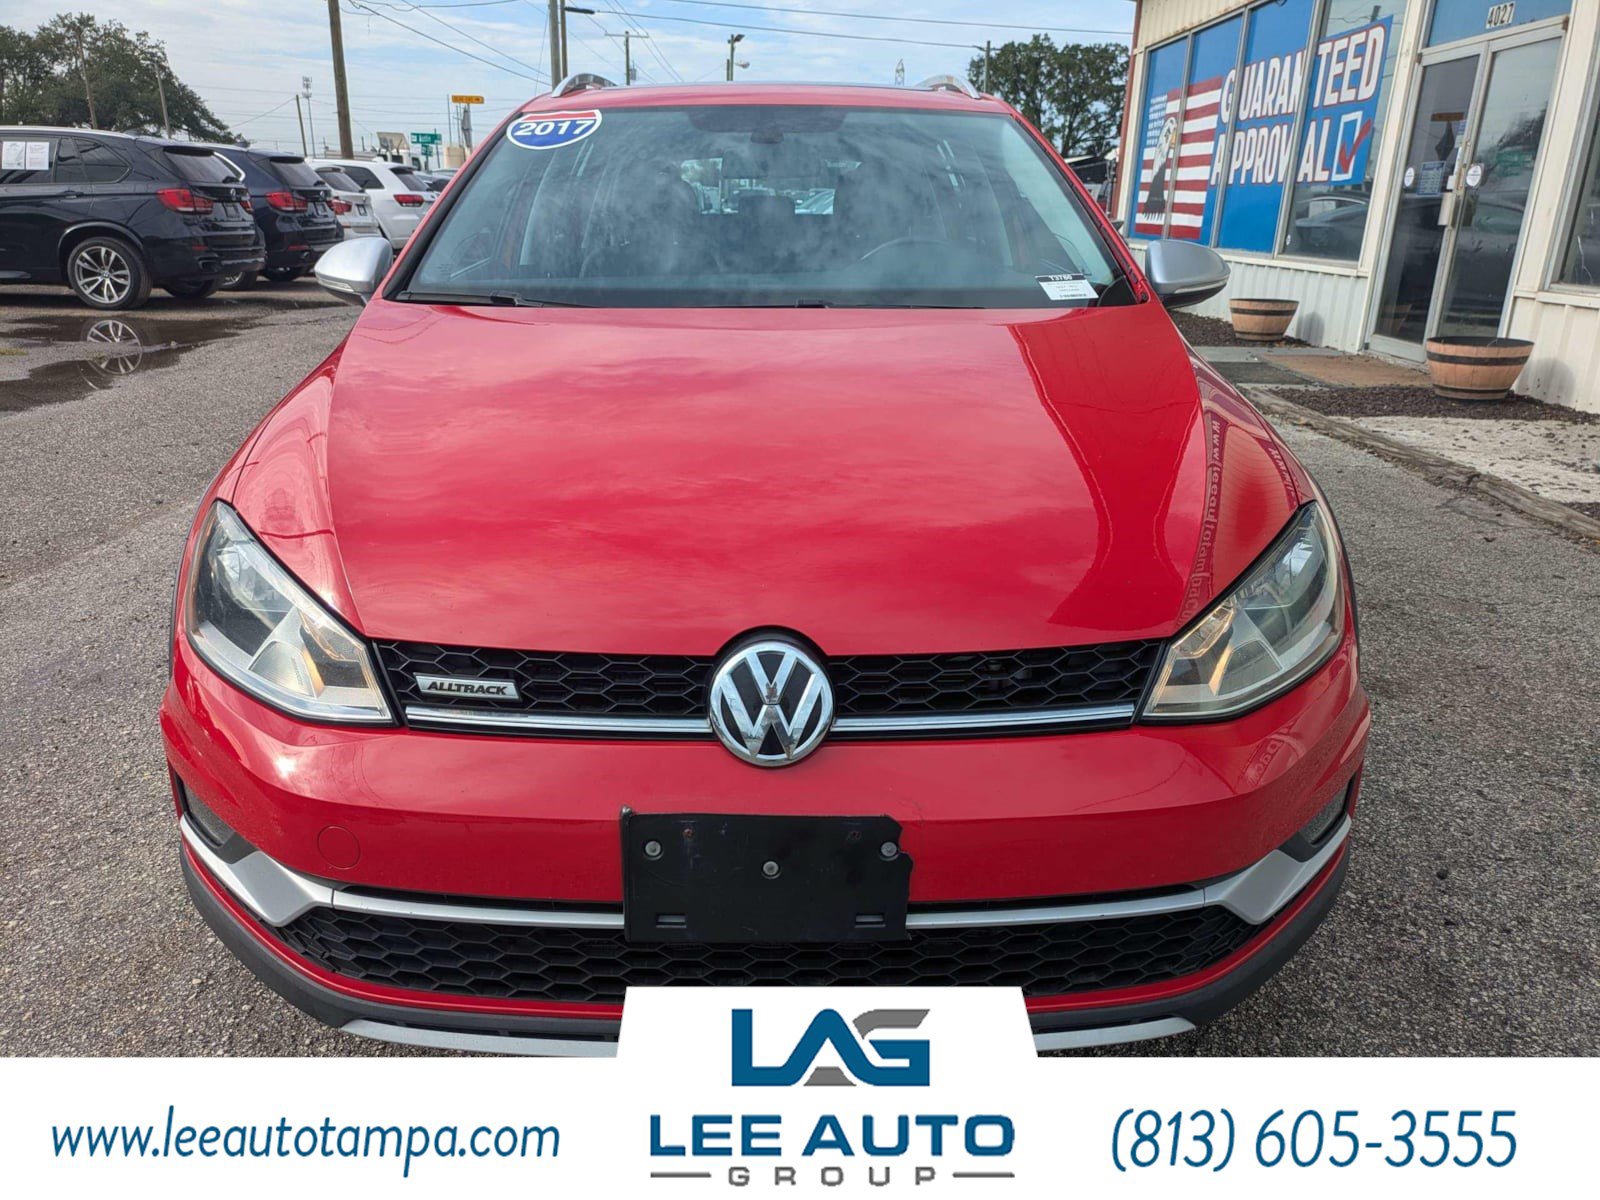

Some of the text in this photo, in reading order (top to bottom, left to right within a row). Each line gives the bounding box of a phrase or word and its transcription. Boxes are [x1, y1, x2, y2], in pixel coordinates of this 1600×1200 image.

[1488, 2, 1514, 26] 4027
[1220, 25, 1386, 124] GUARANTEED
[513, 120, 595, 136] 2017
[1210, 118, 1332, 186] APPROVAL
[427, 681, 508, 696] ALLTRACK
